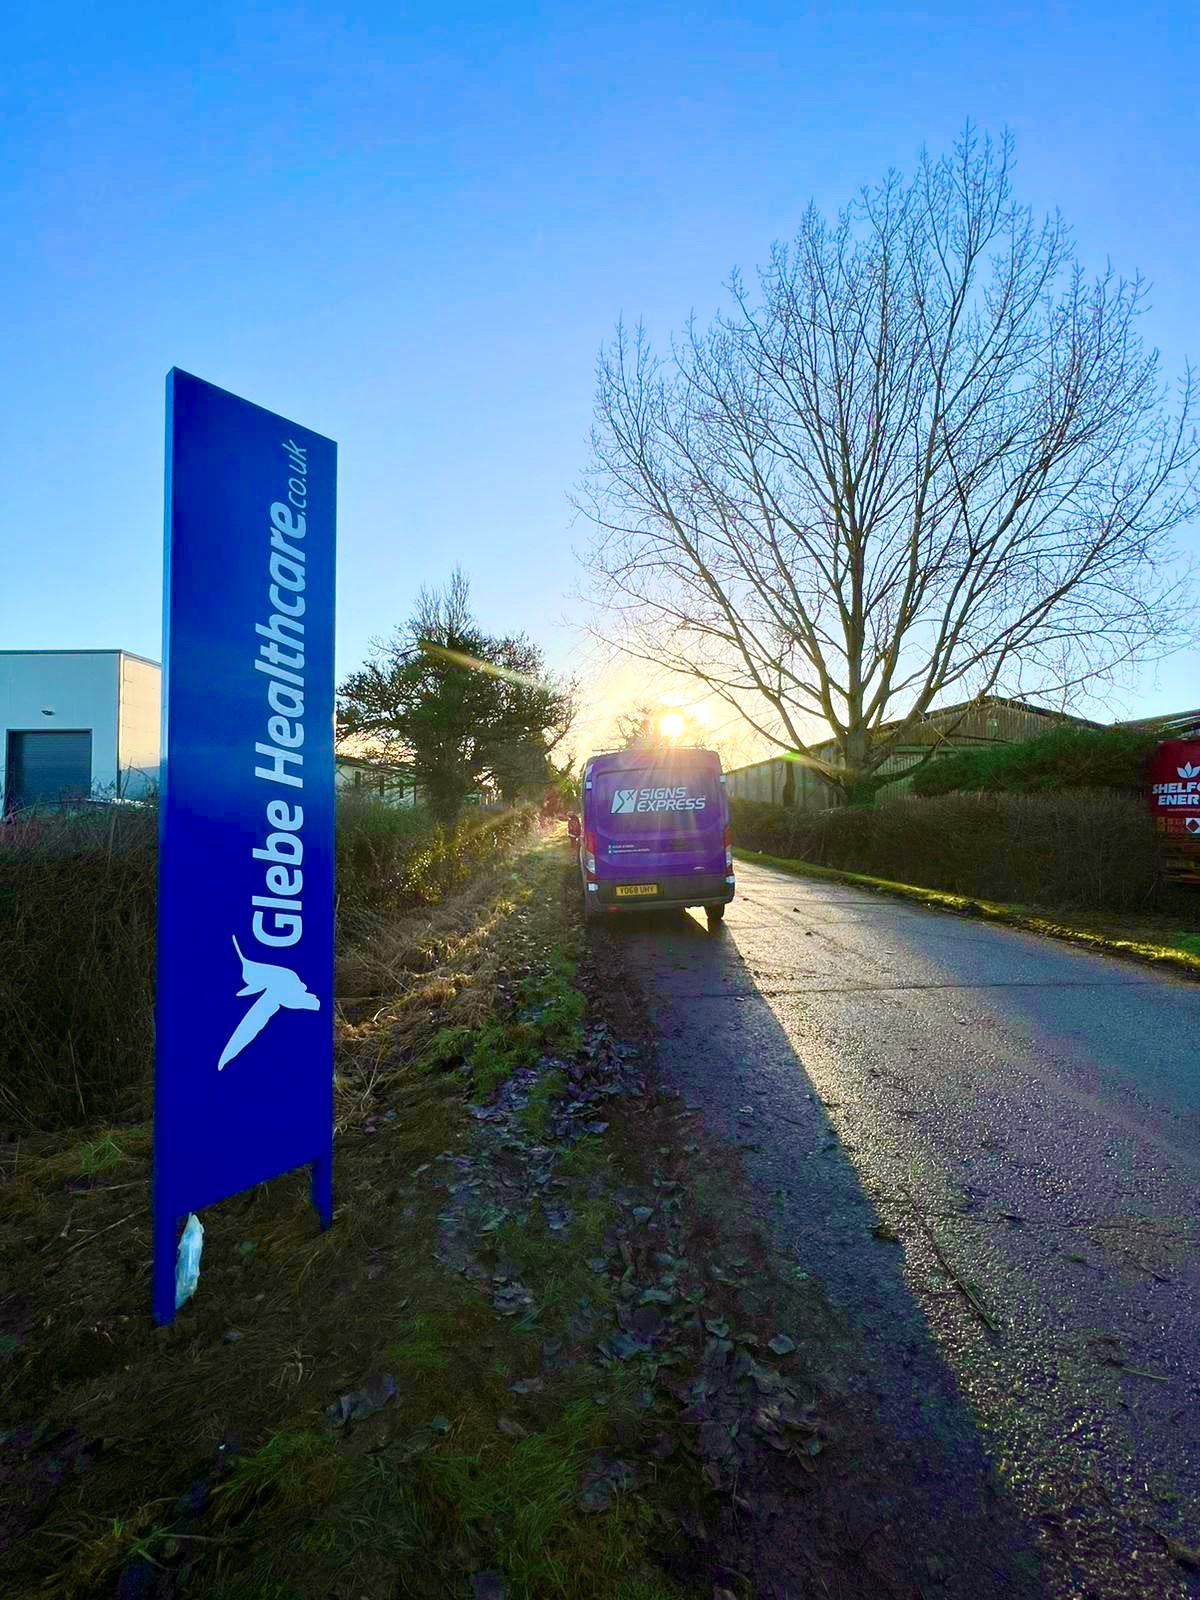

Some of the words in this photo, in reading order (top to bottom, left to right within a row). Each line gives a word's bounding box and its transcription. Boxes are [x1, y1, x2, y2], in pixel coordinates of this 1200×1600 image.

[639, 787, 687, 800] SIGNS
[637, 797, 706, 812] EXPRESS
[252, 800, 304, 948] Glebe
